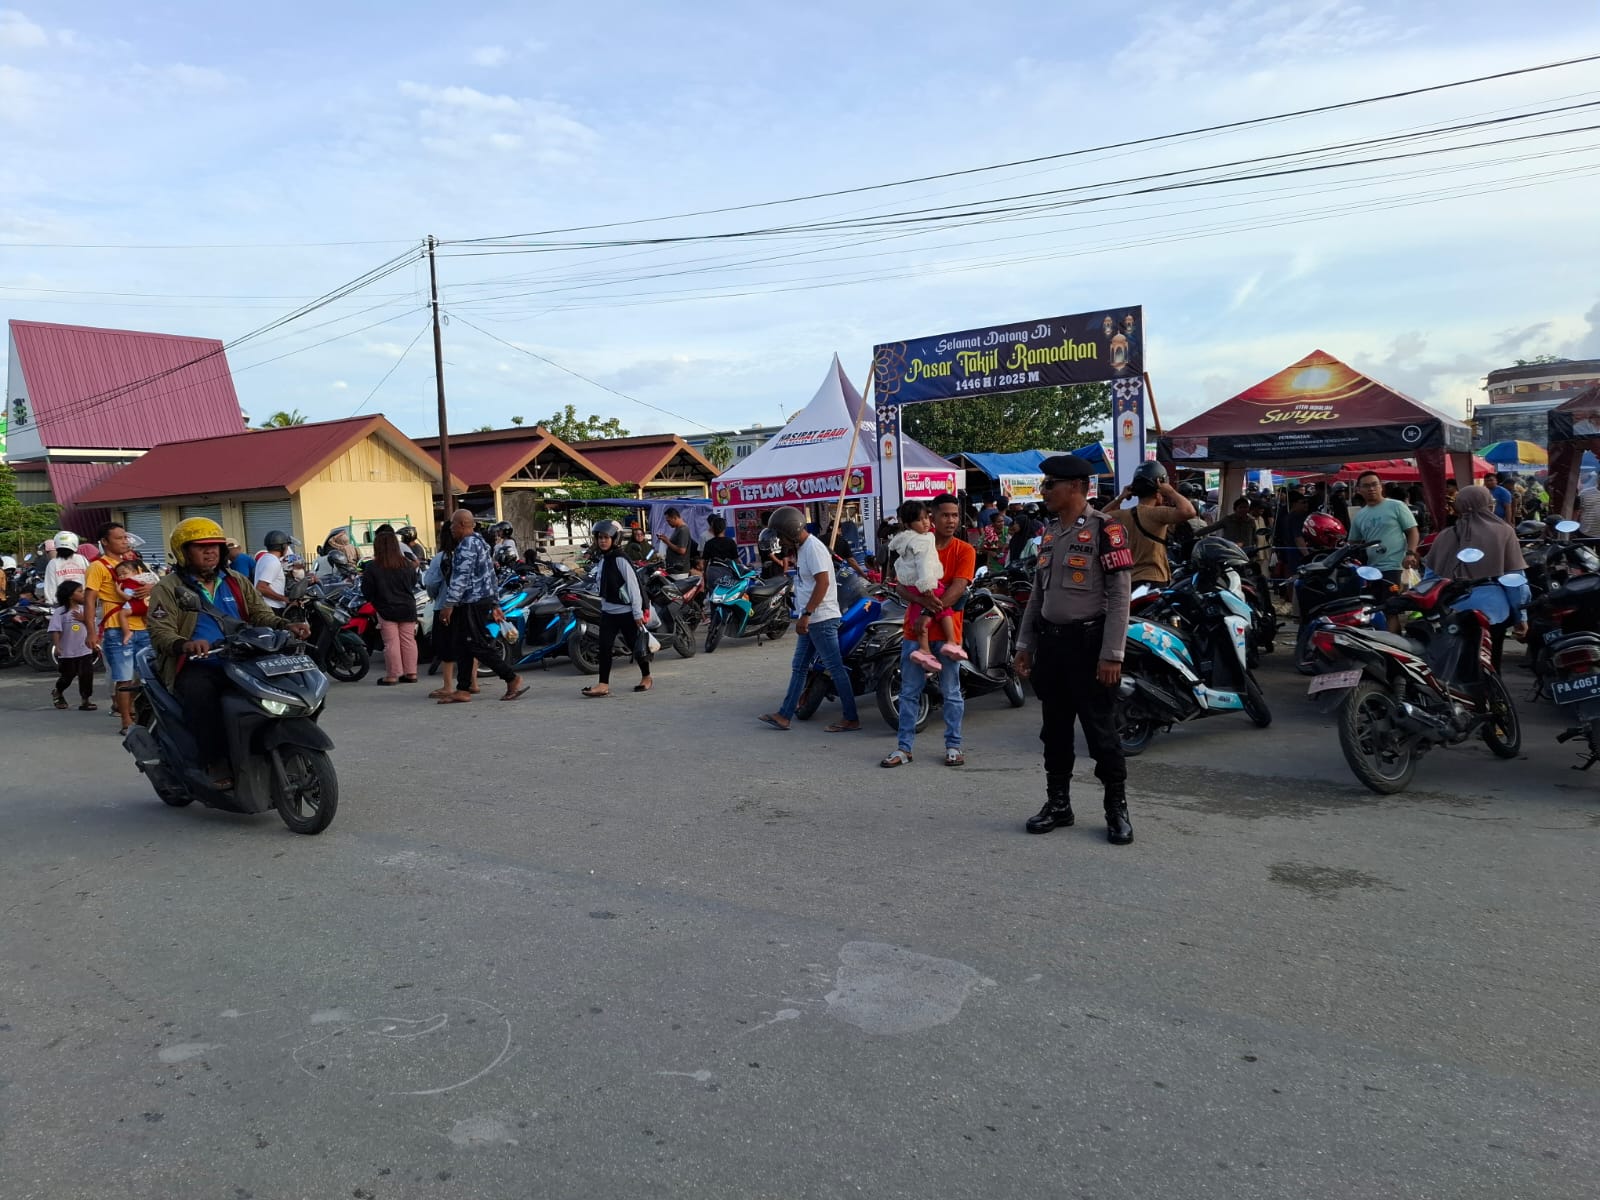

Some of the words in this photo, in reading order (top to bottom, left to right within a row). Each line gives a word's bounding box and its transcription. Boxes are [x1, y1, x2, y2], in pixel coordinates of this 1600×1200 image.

[935, 336, 981, 355] Selamat
[983, 331, 1028, 345] Datang
[1031, 324, 1051, 339] Di
[904, 358, 952, 383] Pasar
[956, 348, 998, 377] Takjil
[1006, 338, 1098, 371] Ramadhan
[956, 378, 981, 391] 1446
[983, 376, 992, 388] H
[999, 372, 1026, 386] 2025
[1028, 371, 1040, 383] M
[1259, 409, 1340, 424] Surya
[738, 482, 785, 501] TEFLON
[1069, 543, 1093, 554] POLRI
[1557, 682, 1571, 693] PA
[1573, 675, 1598, 689] 4067
